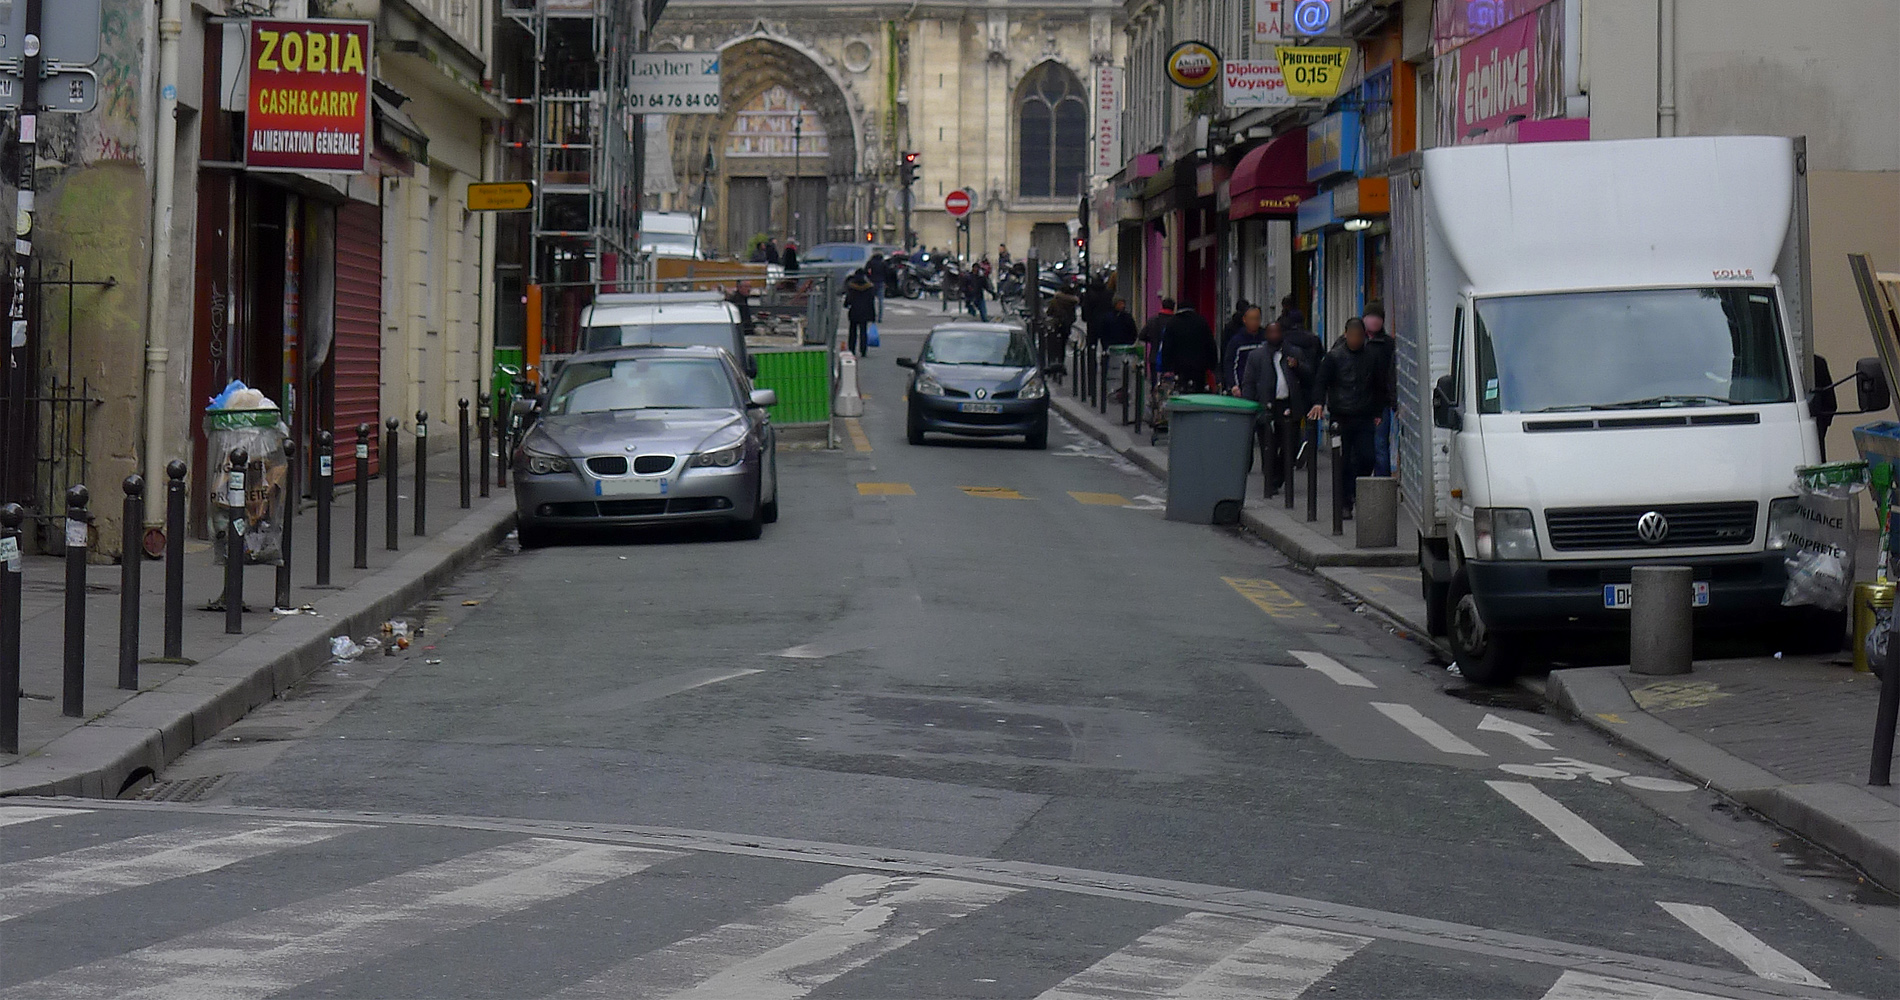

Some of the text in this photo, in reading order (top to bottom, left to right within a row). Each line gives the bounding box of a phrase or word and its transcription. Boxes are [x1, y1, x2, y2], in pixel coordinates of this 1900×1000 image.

[258, 30, 365, 74] ZOBIA
[1282, 51, 1343, 67] PHOTOCOPIE
[631, 59, 694, 80] Layher
[1226, 63, 1281, 76] Diploma
[1228, 78, 1285, 90] Voyage
[259, 88, 358, 117] CASH&CARRY
[630, 94, 719, 107] 01 64 76 84 00
[252, 130, 314, 154] ALIMENTATION
[1259, 199, 1291, 208] STELLA
